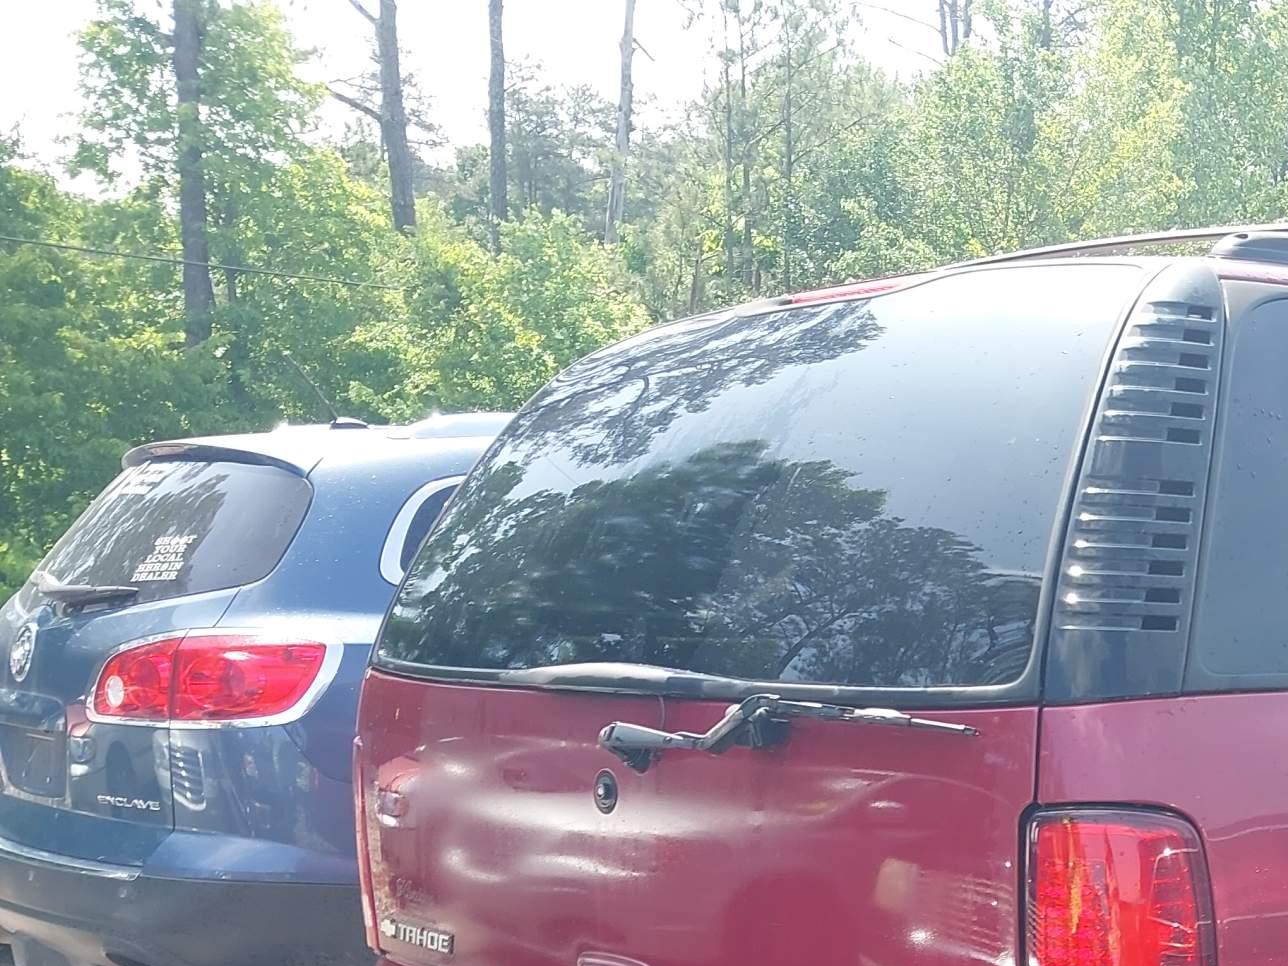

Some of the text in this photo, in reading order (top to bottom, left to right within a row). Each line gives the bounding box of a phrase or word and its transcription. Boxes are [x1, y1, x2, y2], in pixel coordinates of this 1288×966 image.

[153, 544, 187, 554] YOUR
[144, 552, 183, 563] LOCAL
[136, 562, 184, 572] HEROIN
[130, 571, 178, 582] DEALER
[96, 794, 161, 811] ENCLAVE
[398, 923, 451, 954] TAHOE
